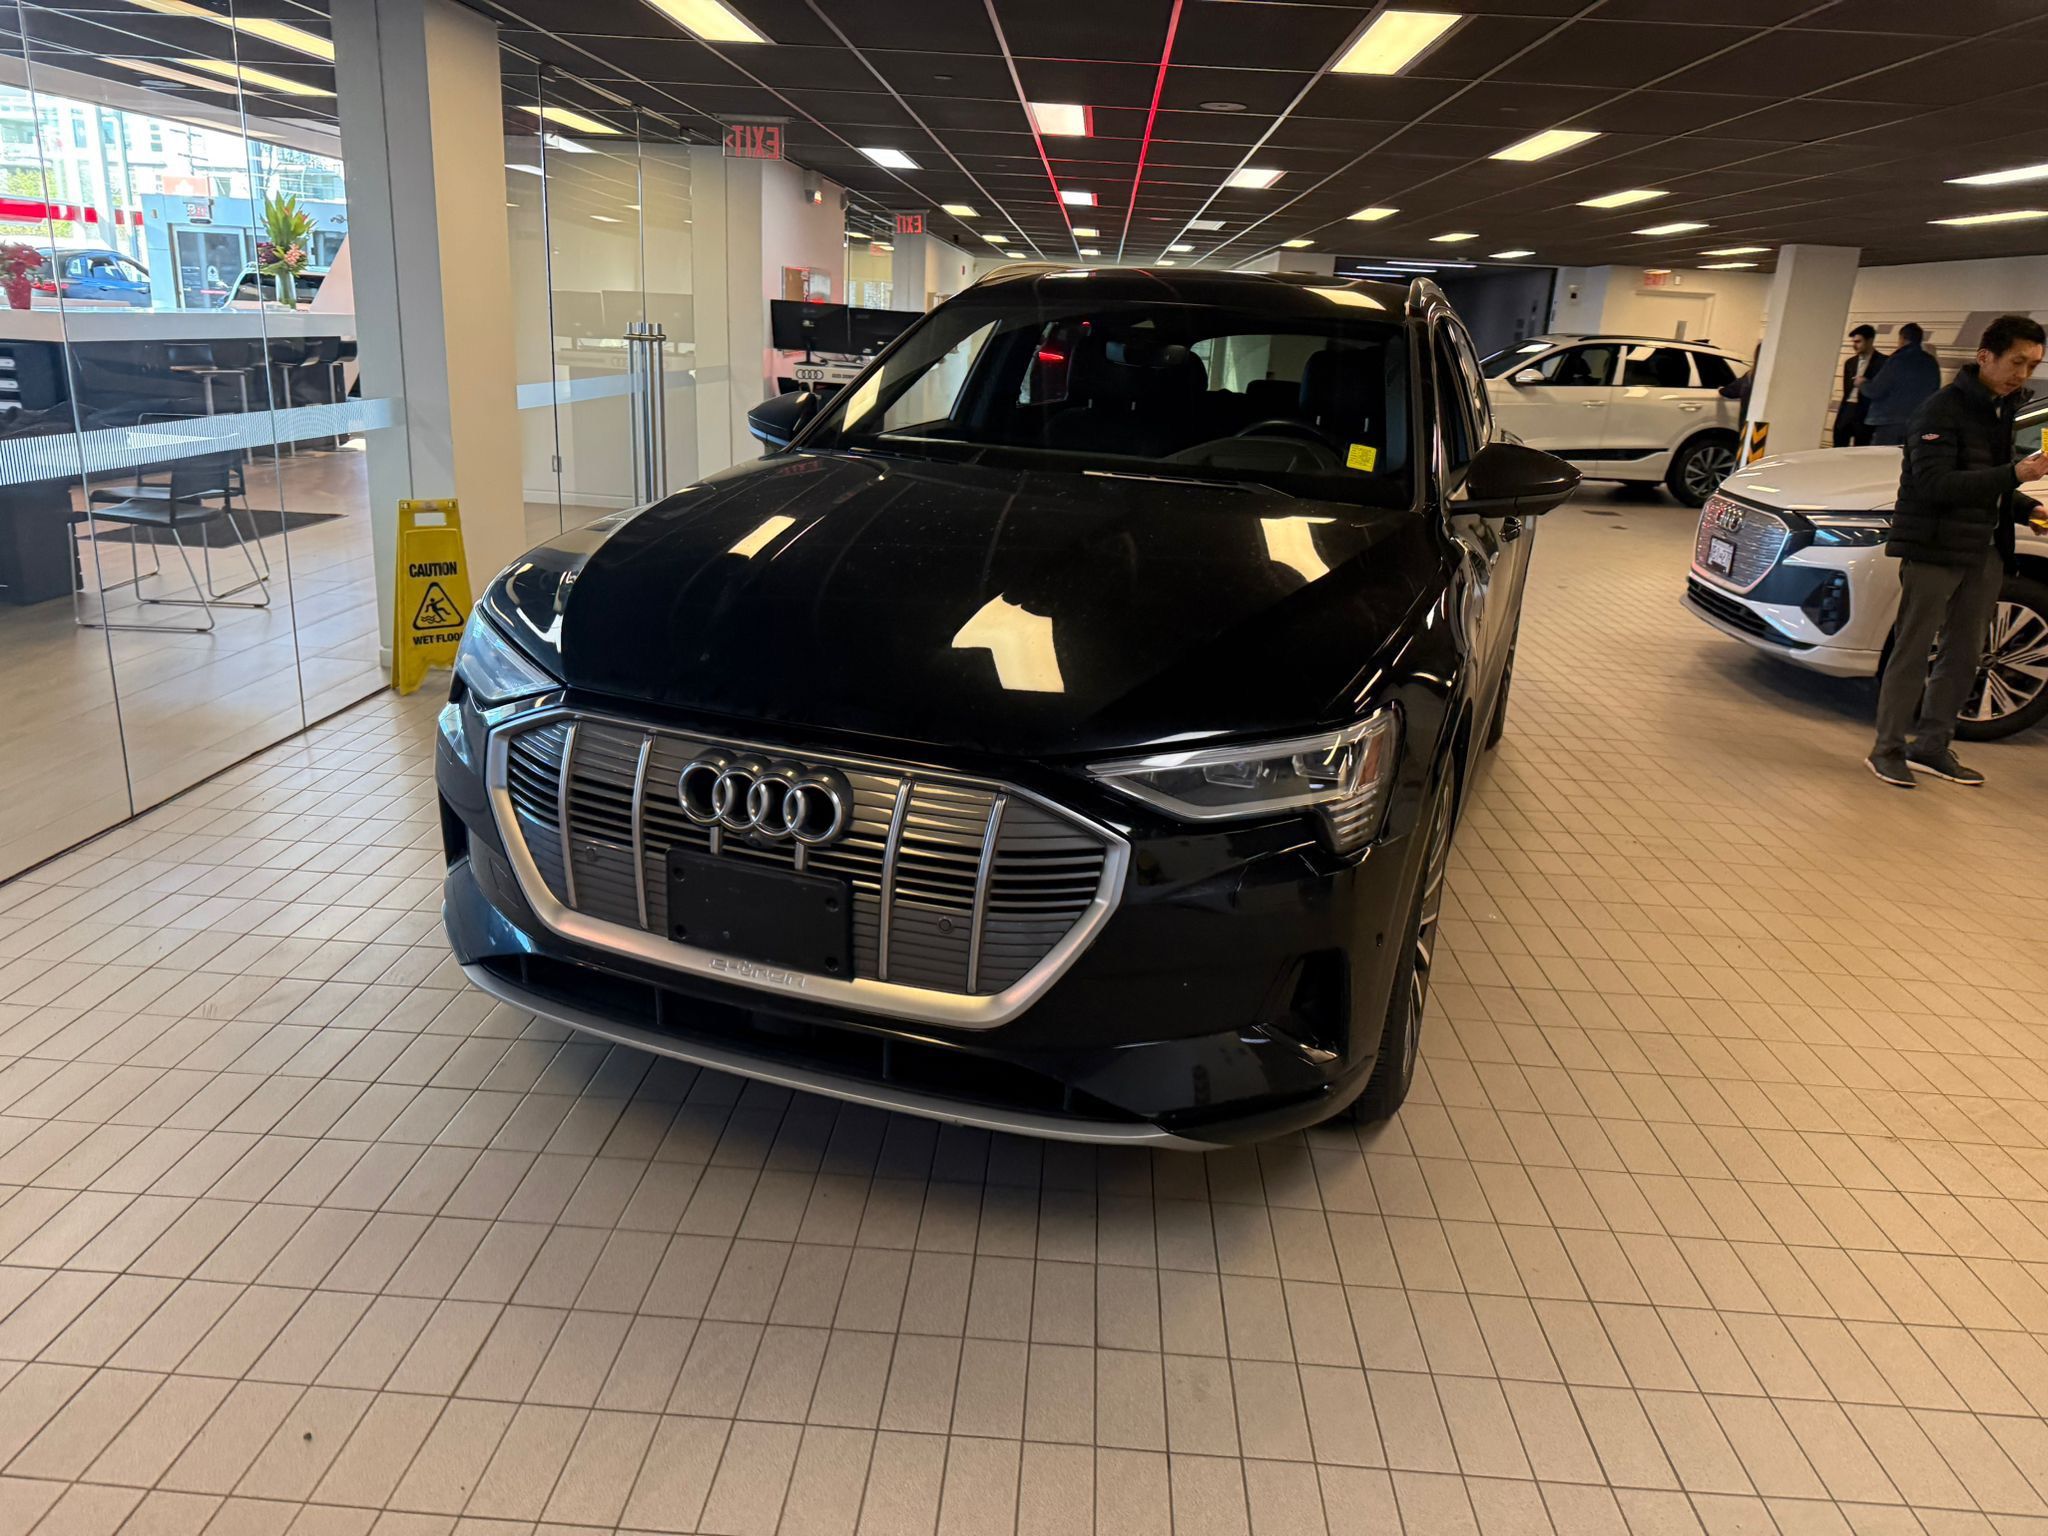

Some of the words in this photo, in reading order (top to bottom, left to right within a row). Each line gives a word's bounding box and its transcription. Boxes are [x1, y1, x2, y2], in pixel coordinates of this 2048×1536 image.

[409, 561, 457, 578] CAUTION
[412, 635, 434, 646] WET
[436, 632, 463, 643] FLOO
[708, 957, 806, 988] e-tron
